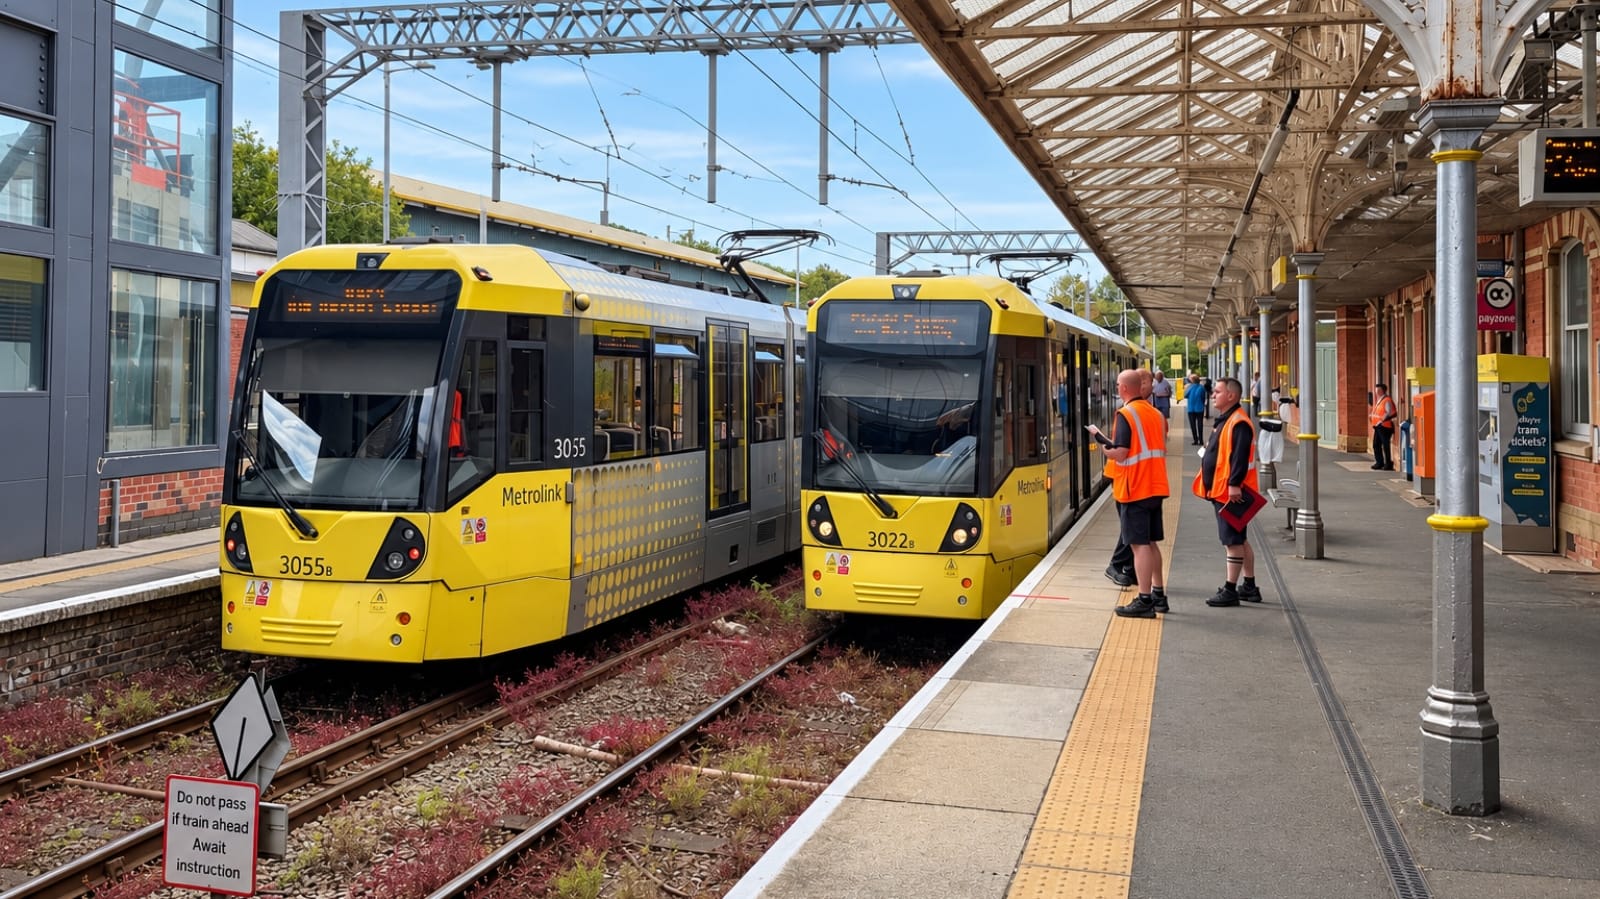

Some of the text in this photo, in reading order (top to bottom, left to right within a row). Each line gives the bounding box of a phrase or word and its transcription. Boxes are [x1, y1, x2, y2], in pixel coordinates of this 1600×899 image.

[1478, 314, 1517, 325] payzone
[1517, 426, 1539, 435] tram
[553, 437, 586, 459] 3055
[502, 484, 562, 507] Metrolink
[177, 790, 247, 811] Do not pass
[172, 812, 249, 834] if train ahead
[192, 837, 226, 855] Await
[176, 858, 241, 879] instruction
